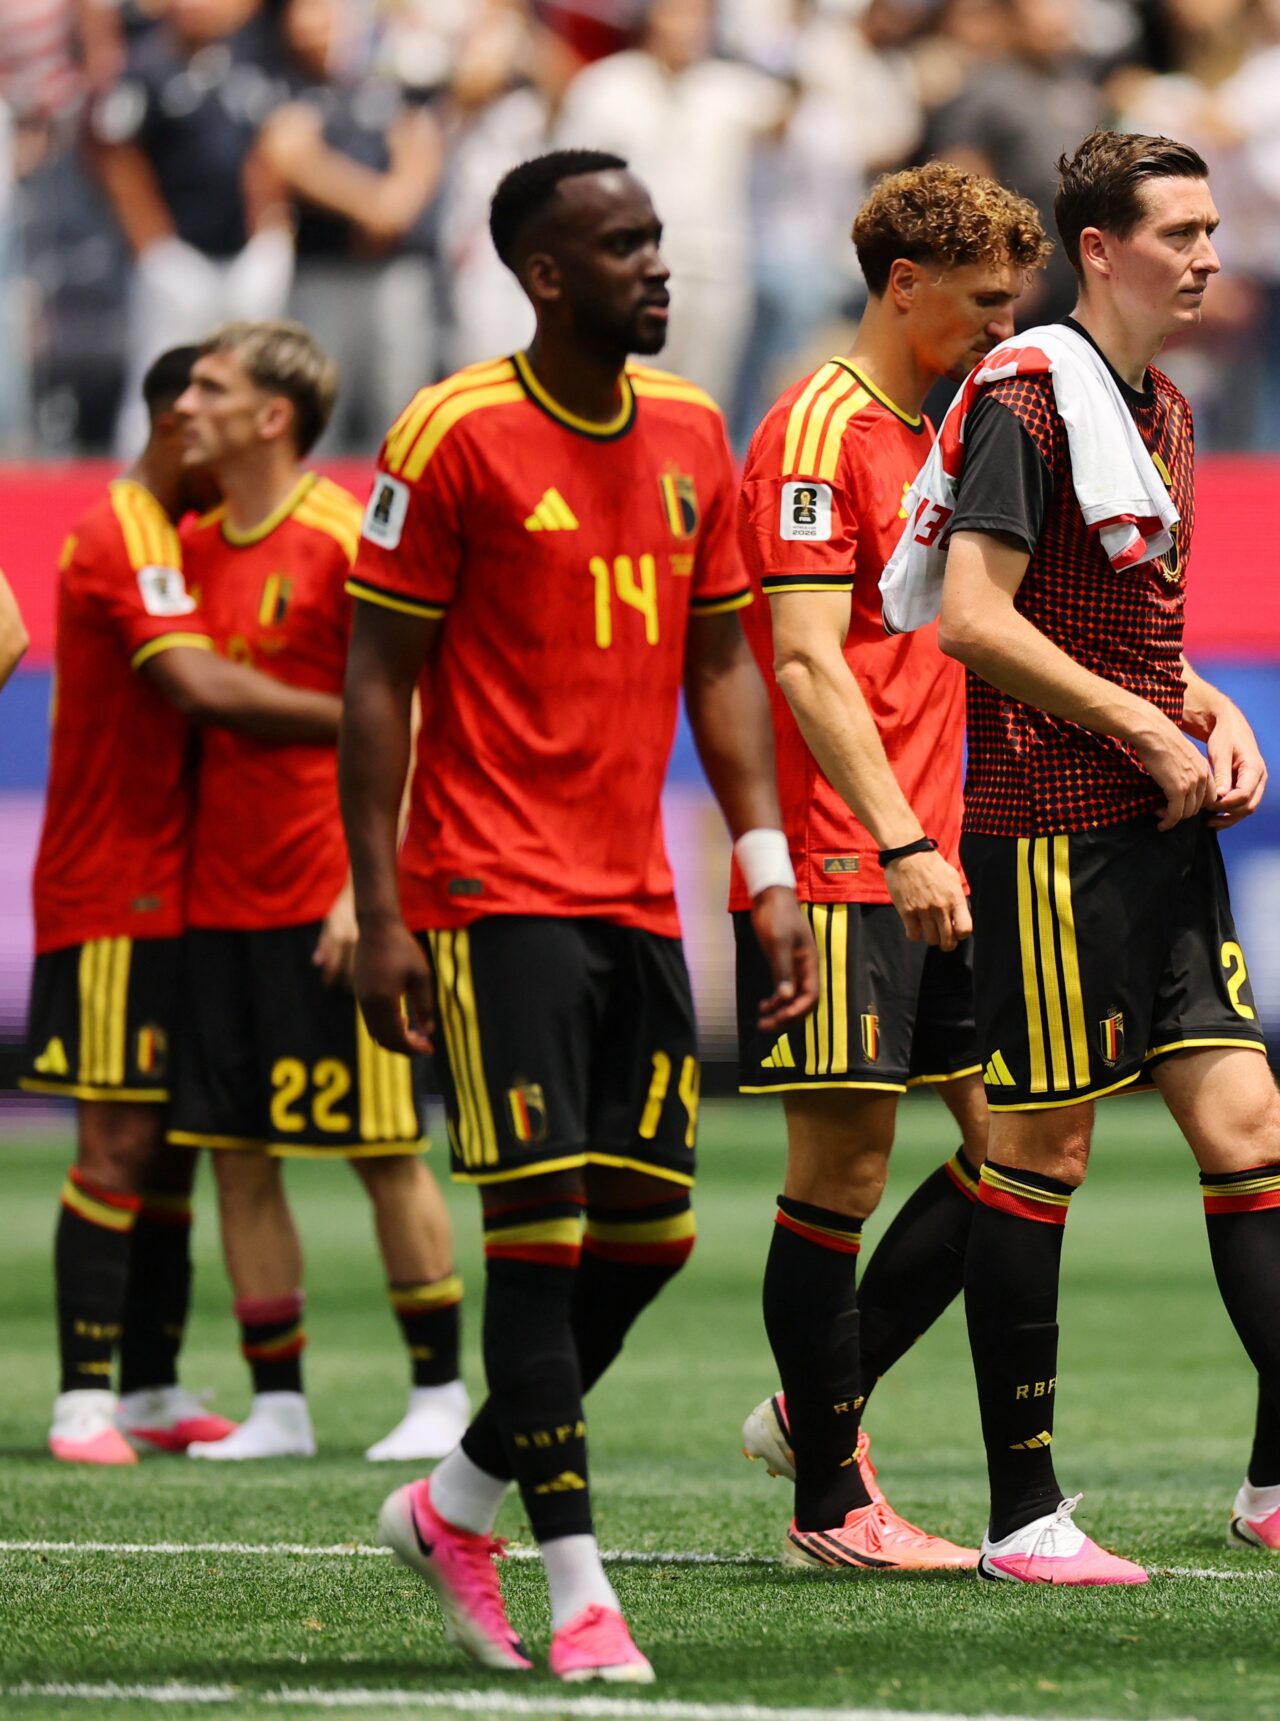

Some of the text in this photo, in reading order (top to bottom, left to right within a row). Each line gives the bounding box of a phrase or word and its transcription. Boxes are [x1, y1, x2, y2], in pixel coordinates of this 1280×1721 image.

[588, 553, 660, 650] 14
[1220, 940, 1256, 1021] 2
[271, 1056, 352, 1133] 22
[638, 1050, 701, 1149] 14
